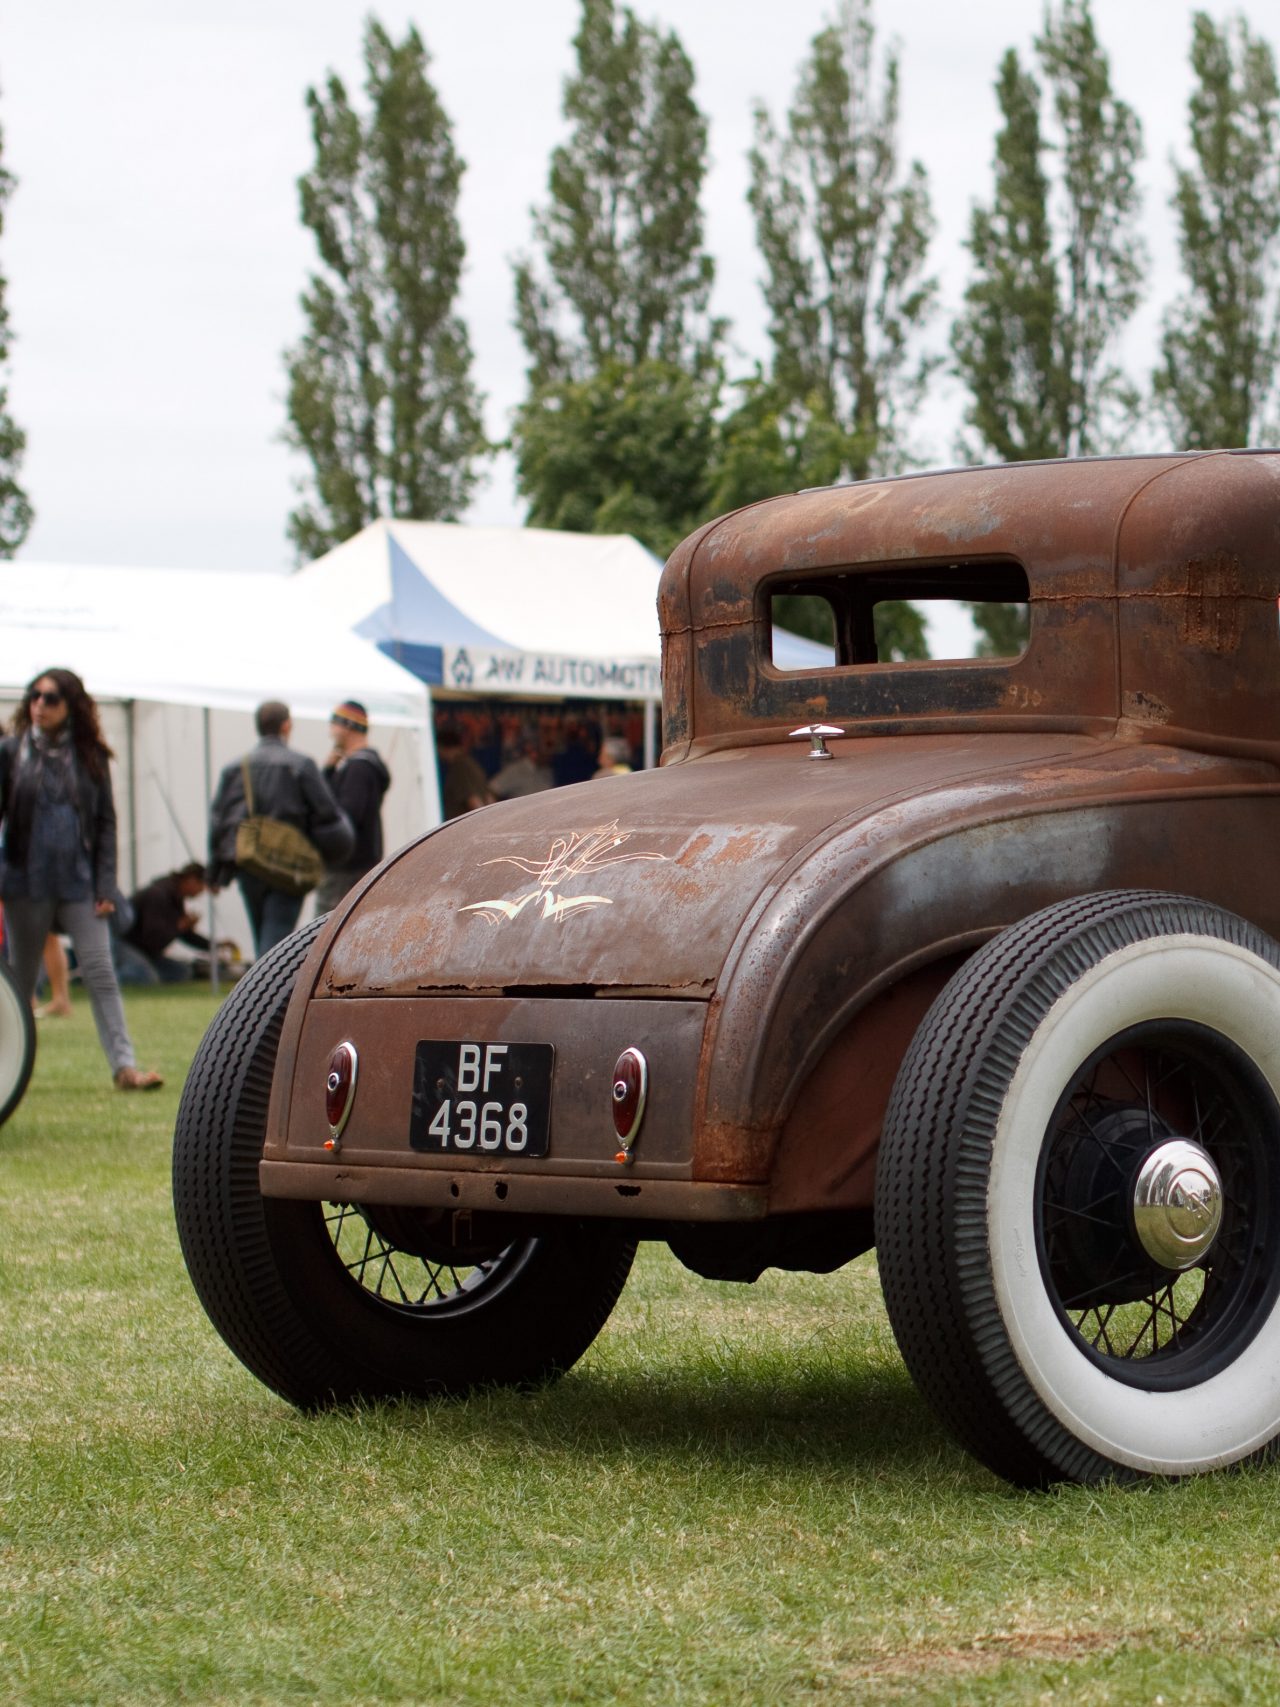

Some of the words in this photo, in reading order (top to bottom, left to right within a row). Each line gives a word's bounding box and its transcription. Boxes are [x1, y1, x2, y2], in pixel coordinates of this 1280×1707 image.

[486, 656, 523, 681] AW
[457, 1044, 509, 1093] BF
[428, 1099, 528, 1151] 4368
